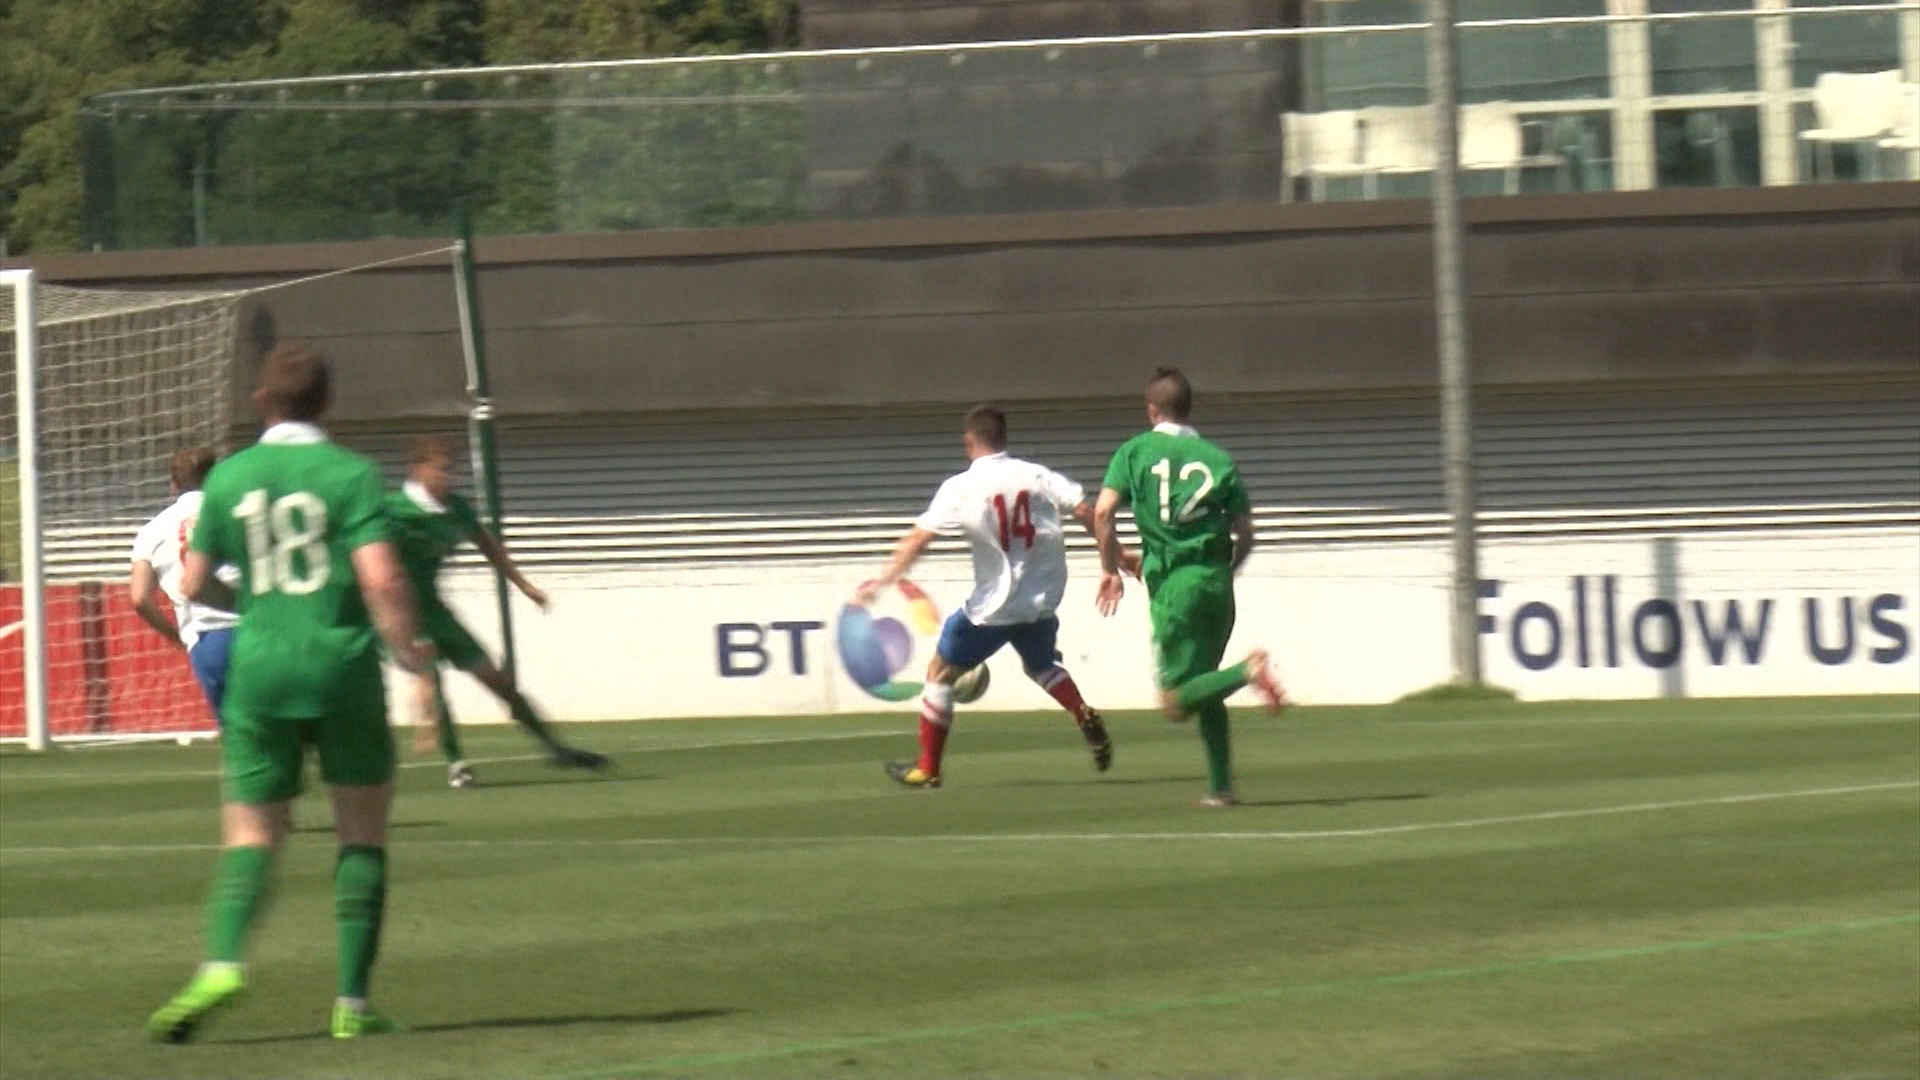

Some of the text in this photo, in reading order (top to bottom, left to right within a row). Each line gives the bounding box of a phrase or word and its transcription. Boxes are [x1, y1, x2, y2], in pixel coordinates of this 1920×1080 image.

[993, 489, 1036, 551] 14
[1151, 457, 1215, 524] 12
[231, 489, 332, 595] 18
[714, 620, 824, 678] BT
[1803, 592, 1910, 666] us
